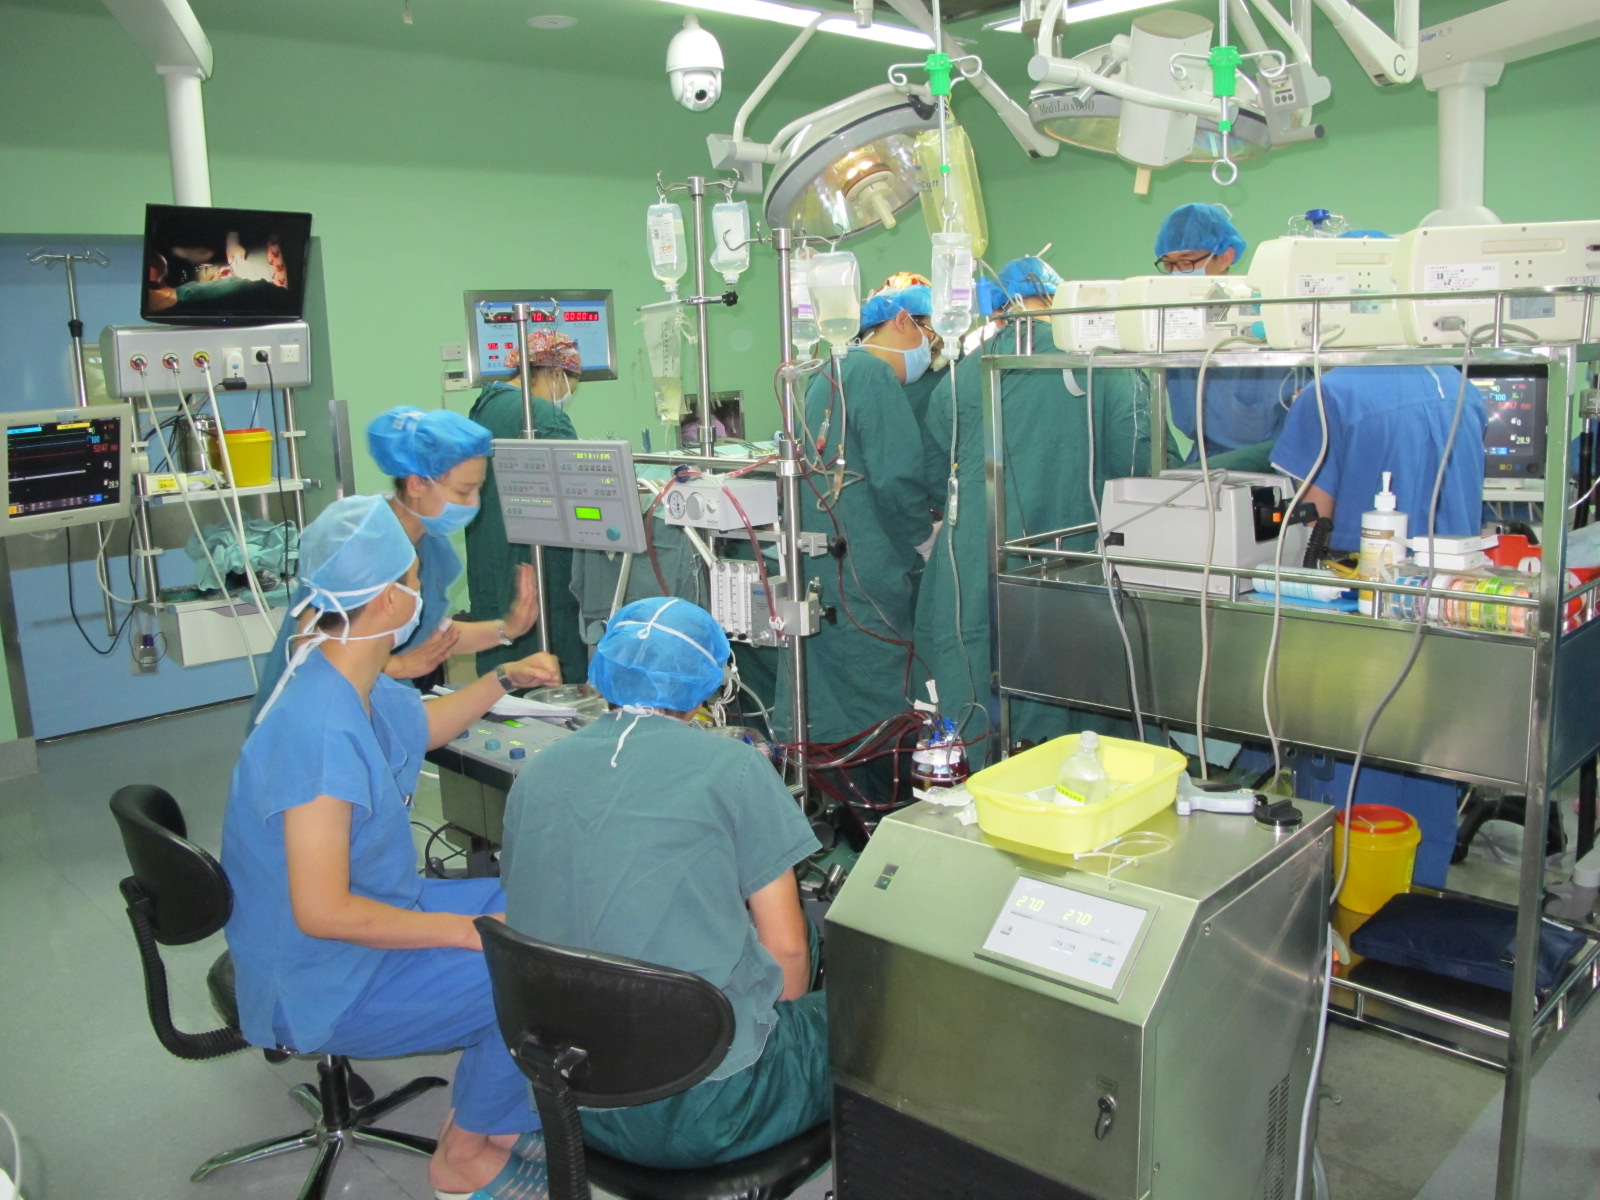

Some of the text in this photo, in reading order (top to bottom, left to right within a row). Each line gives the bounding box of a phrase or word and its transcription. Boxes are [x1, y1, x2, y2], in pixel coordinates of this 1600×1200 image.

[1394, 54, 1406, 76] C
[1495, 393, 1507, 401] 100
[1515, 436, 1530, 444] 28.9
